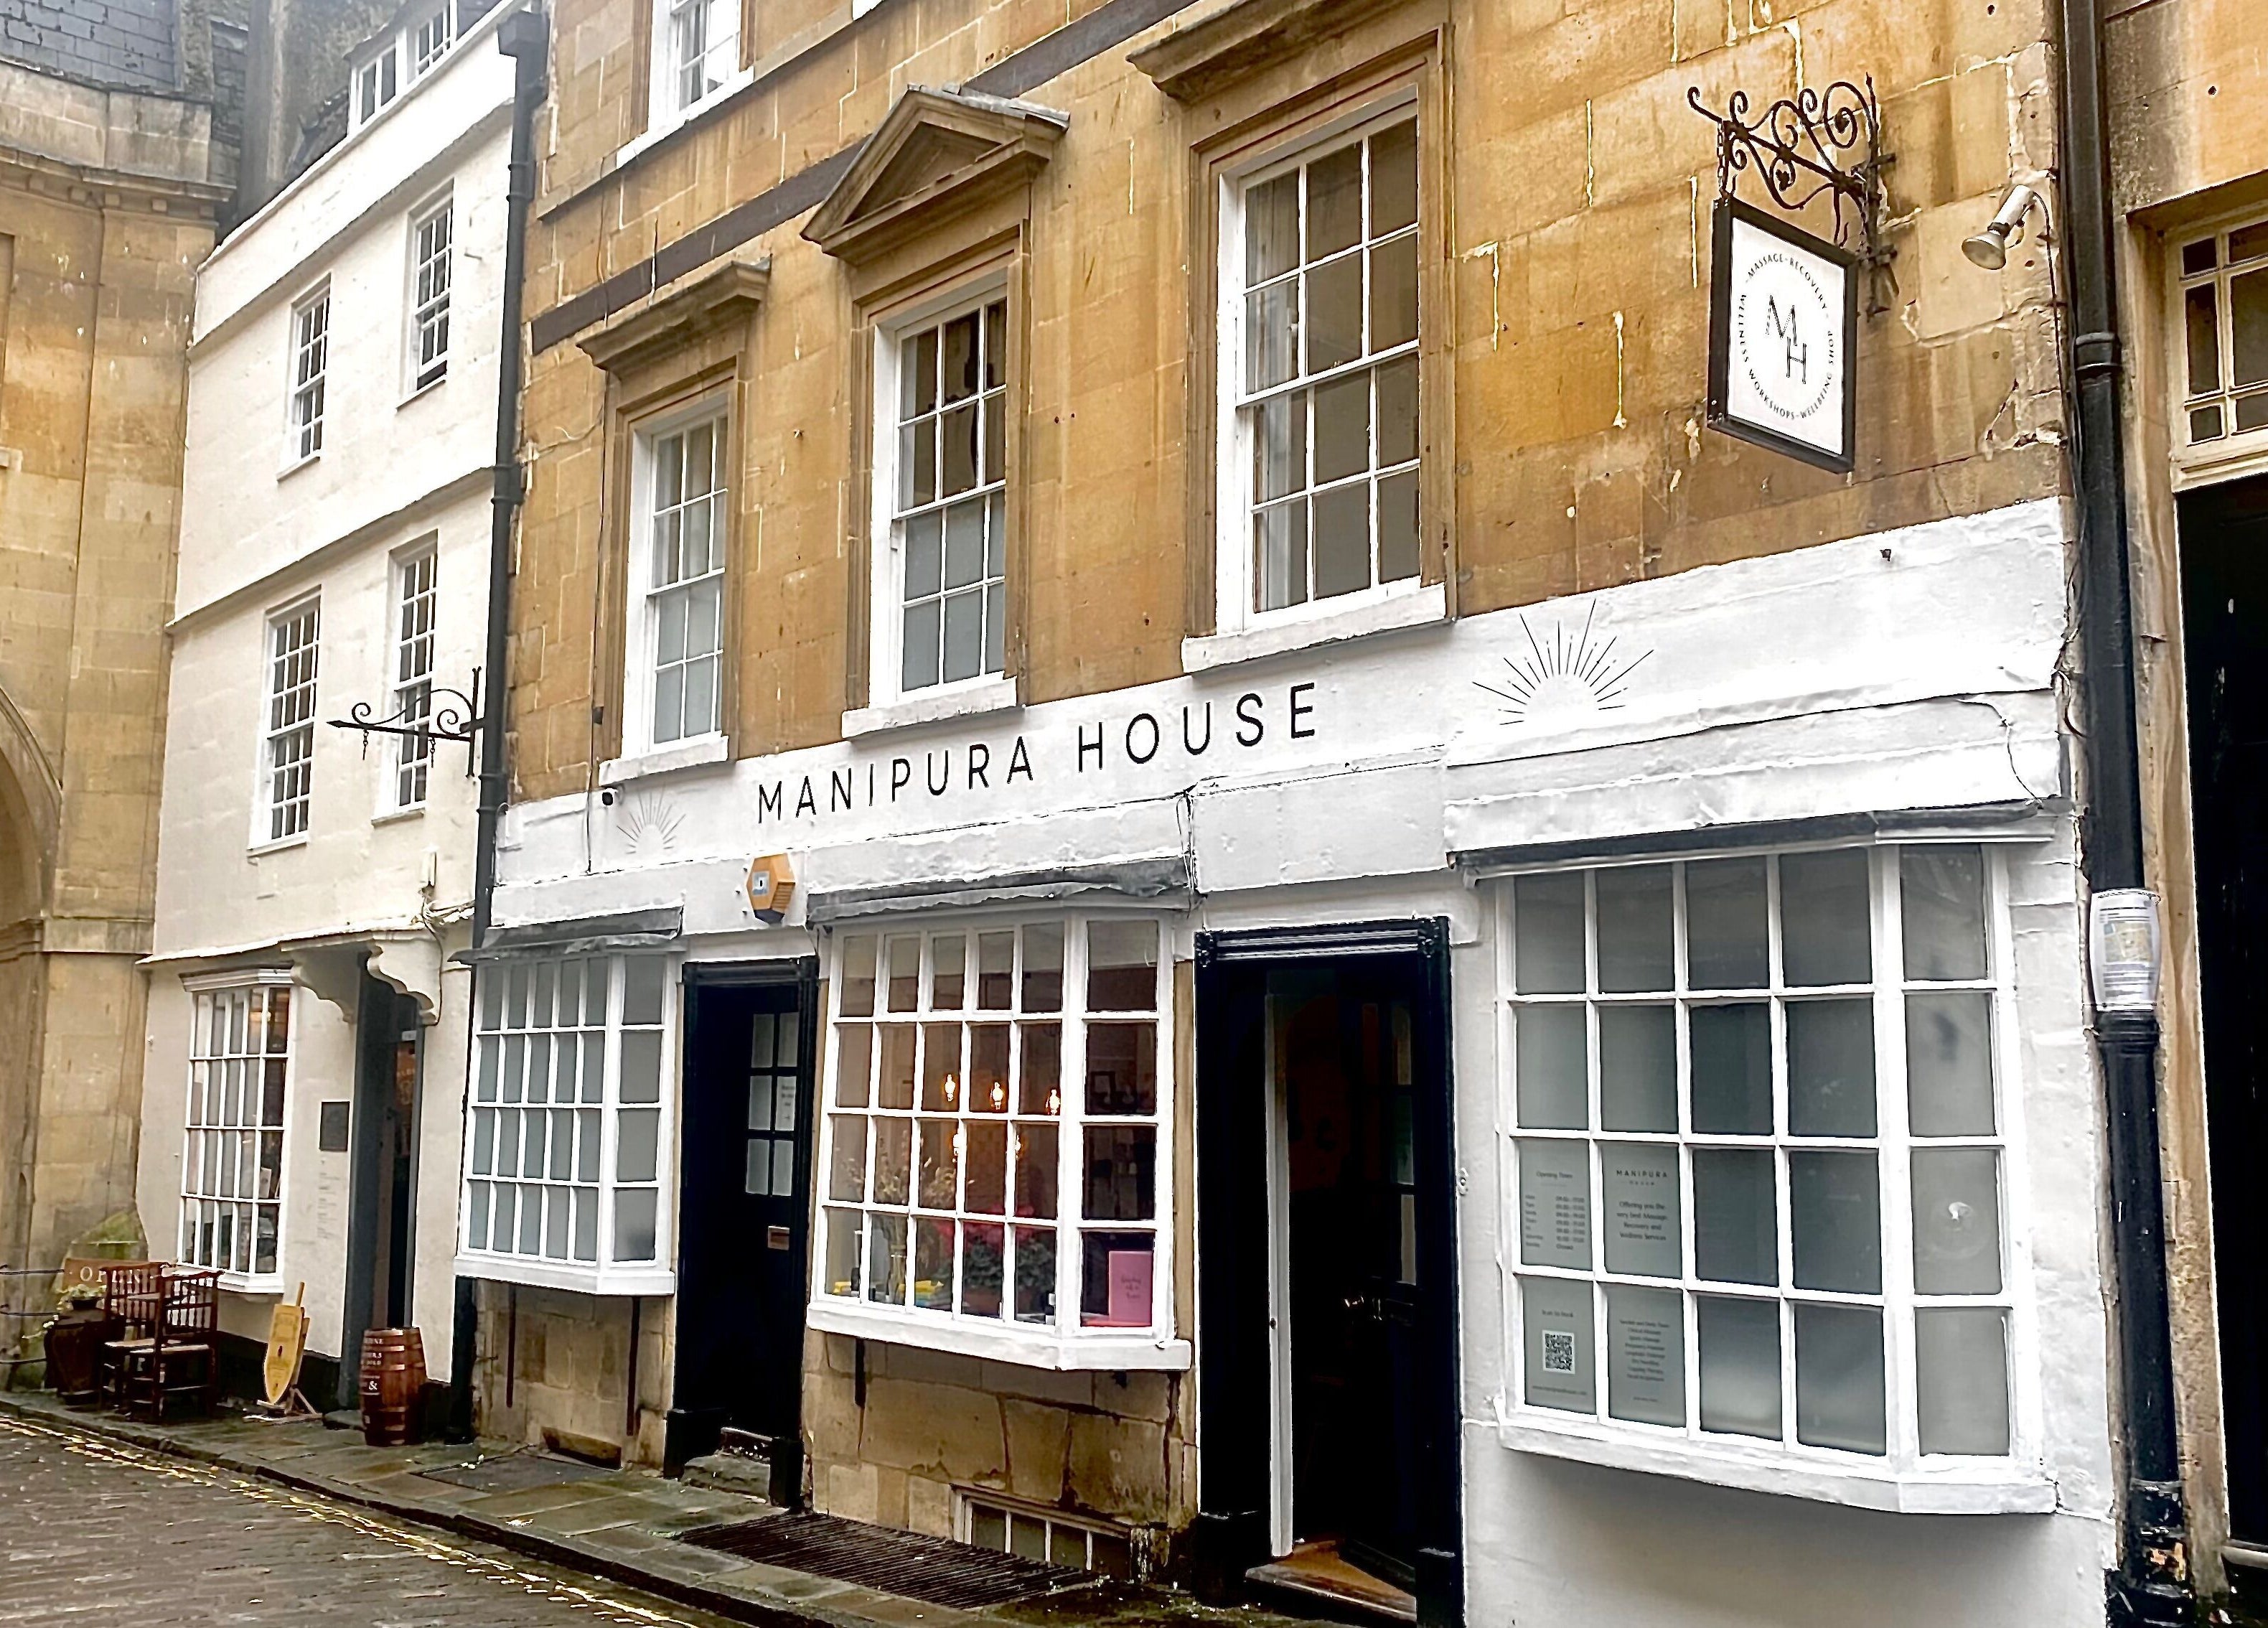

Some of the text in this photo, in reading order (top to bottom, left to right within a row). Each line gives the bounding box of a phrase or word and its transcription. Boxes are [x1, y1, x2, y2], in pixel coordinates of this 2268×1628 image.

[1748, 368, 1795, 420] WORKSHOPS
[758, 683, 1315, 824] MANIPURA HOUSE
